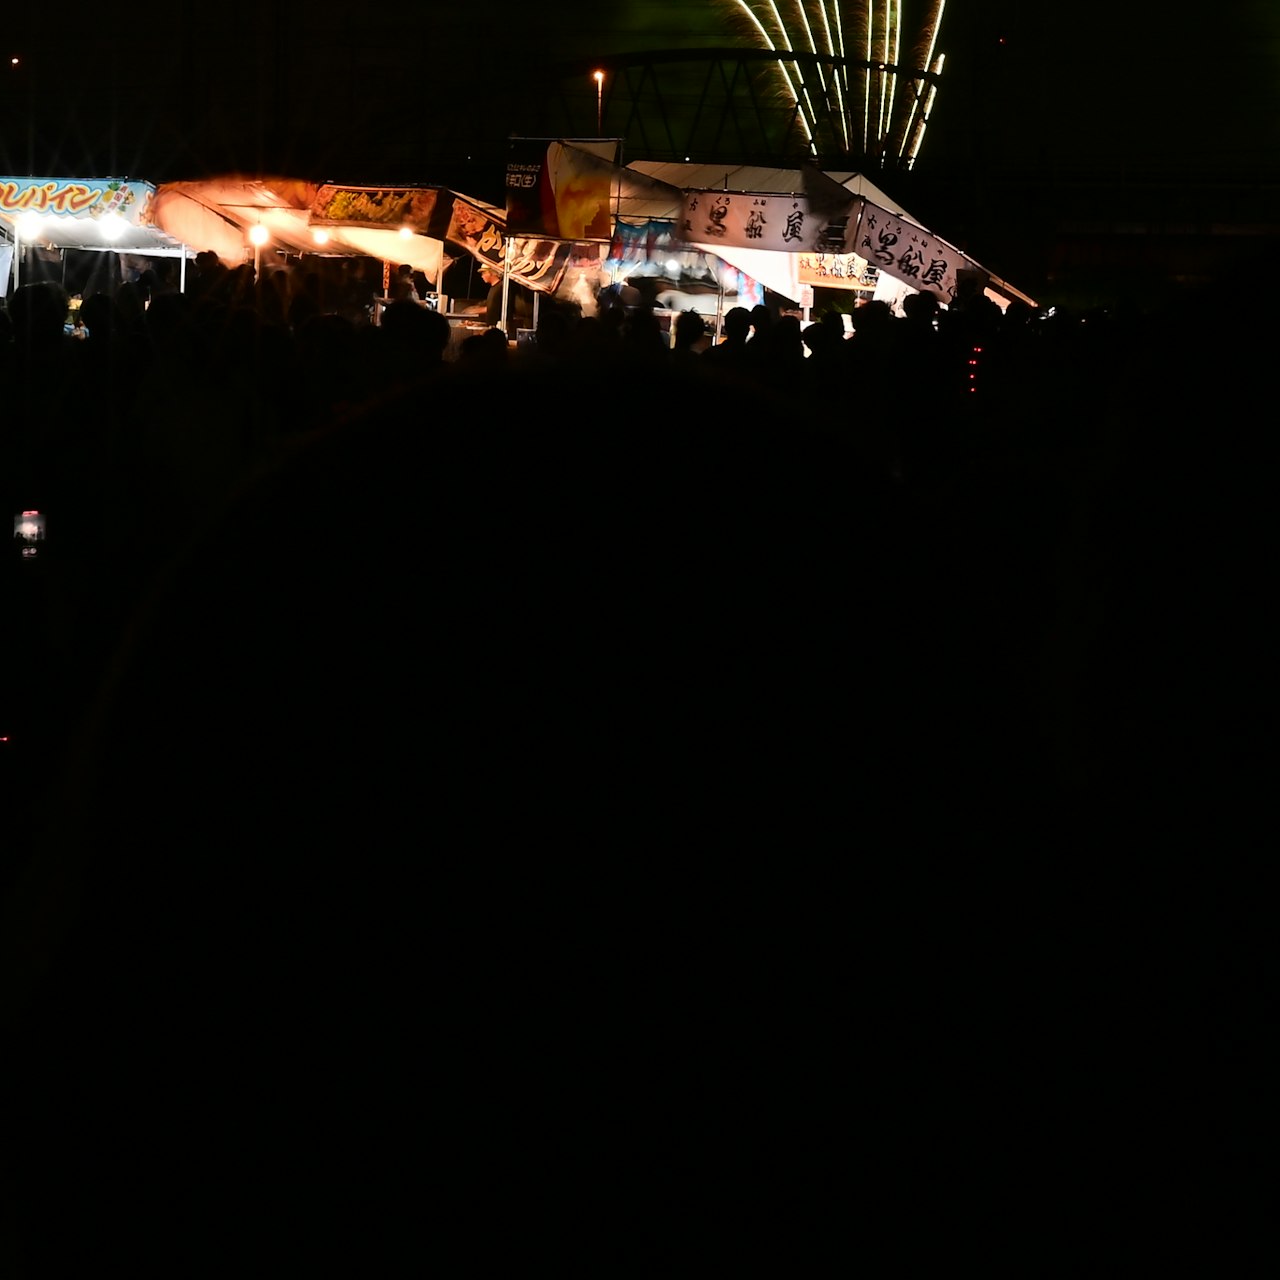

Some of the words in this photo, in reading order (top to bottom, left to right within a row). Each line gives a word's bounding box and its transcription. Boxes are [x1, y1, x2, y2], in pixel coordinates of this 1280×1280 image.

[704, 205, 803, 243] 黒船屋
[875, 228, 948, 291] 黒船屋
